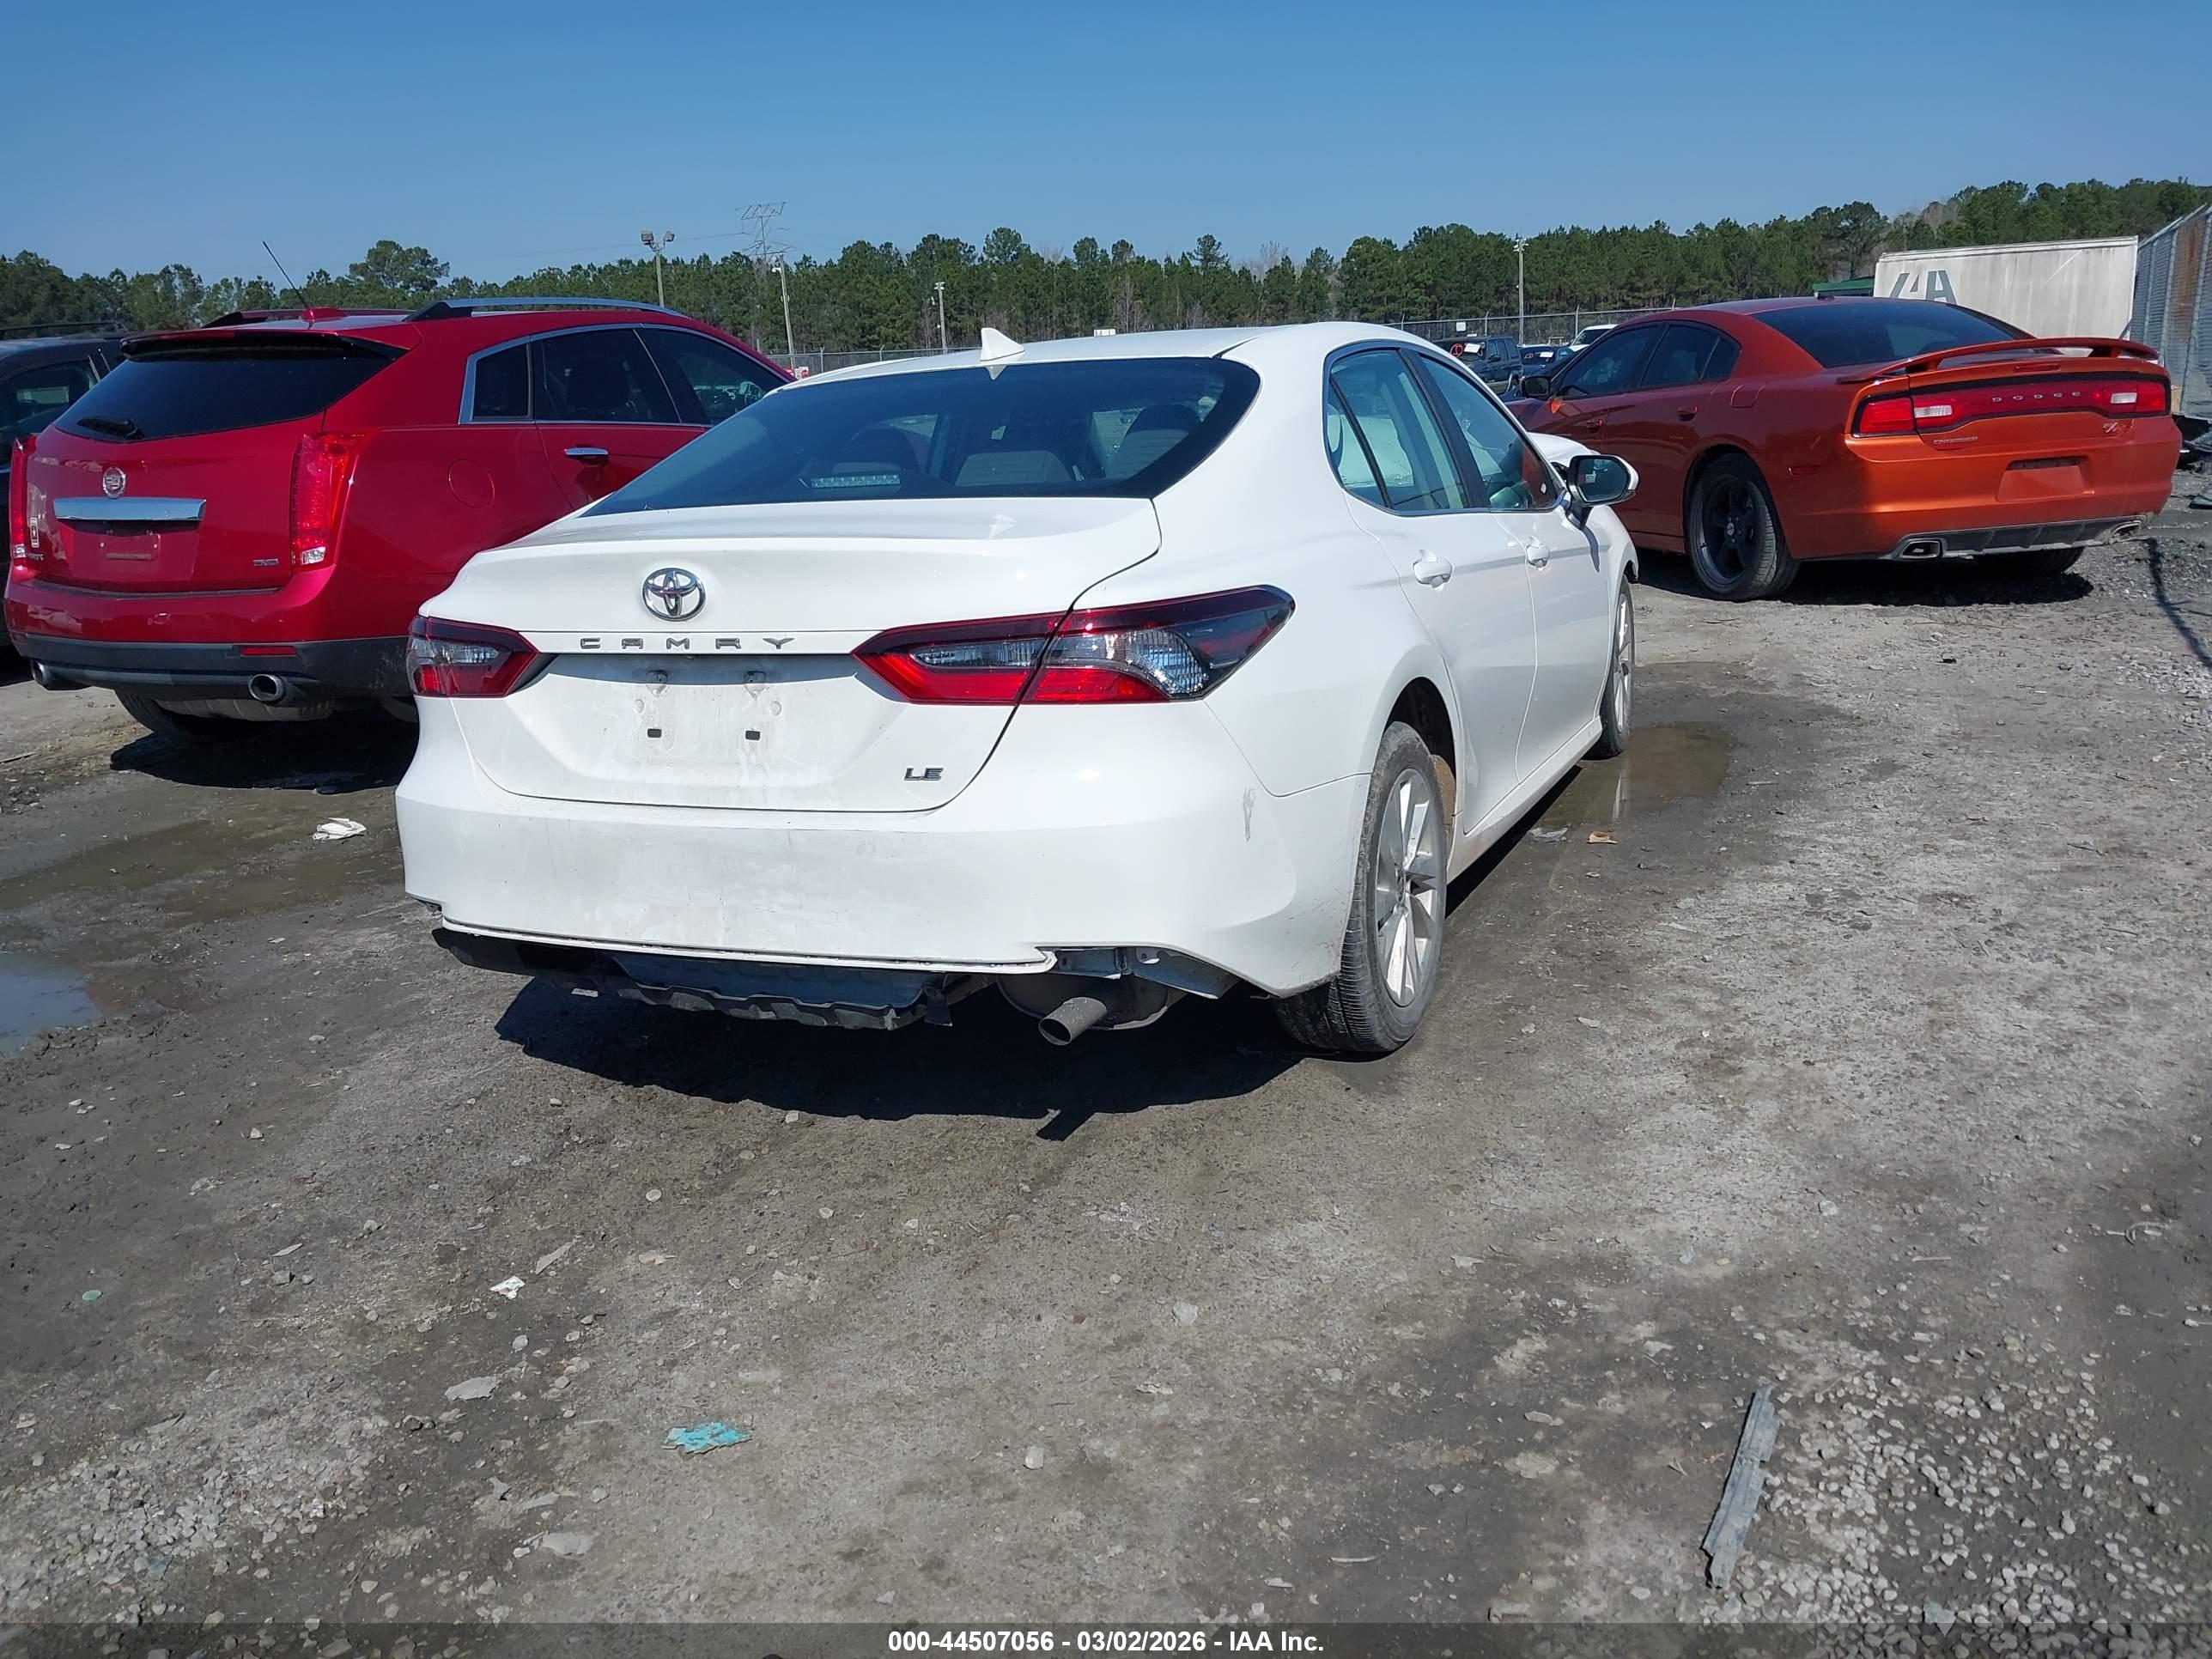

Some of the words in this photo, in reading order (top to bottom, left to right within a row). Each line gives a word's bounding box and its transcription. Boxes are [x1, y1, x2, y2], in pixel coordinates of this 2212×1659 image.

[1992, 392, 2081, 403] DODGE
[580, 637, 795, 650] CAMRY
[903, 767, 944, 781] LE
